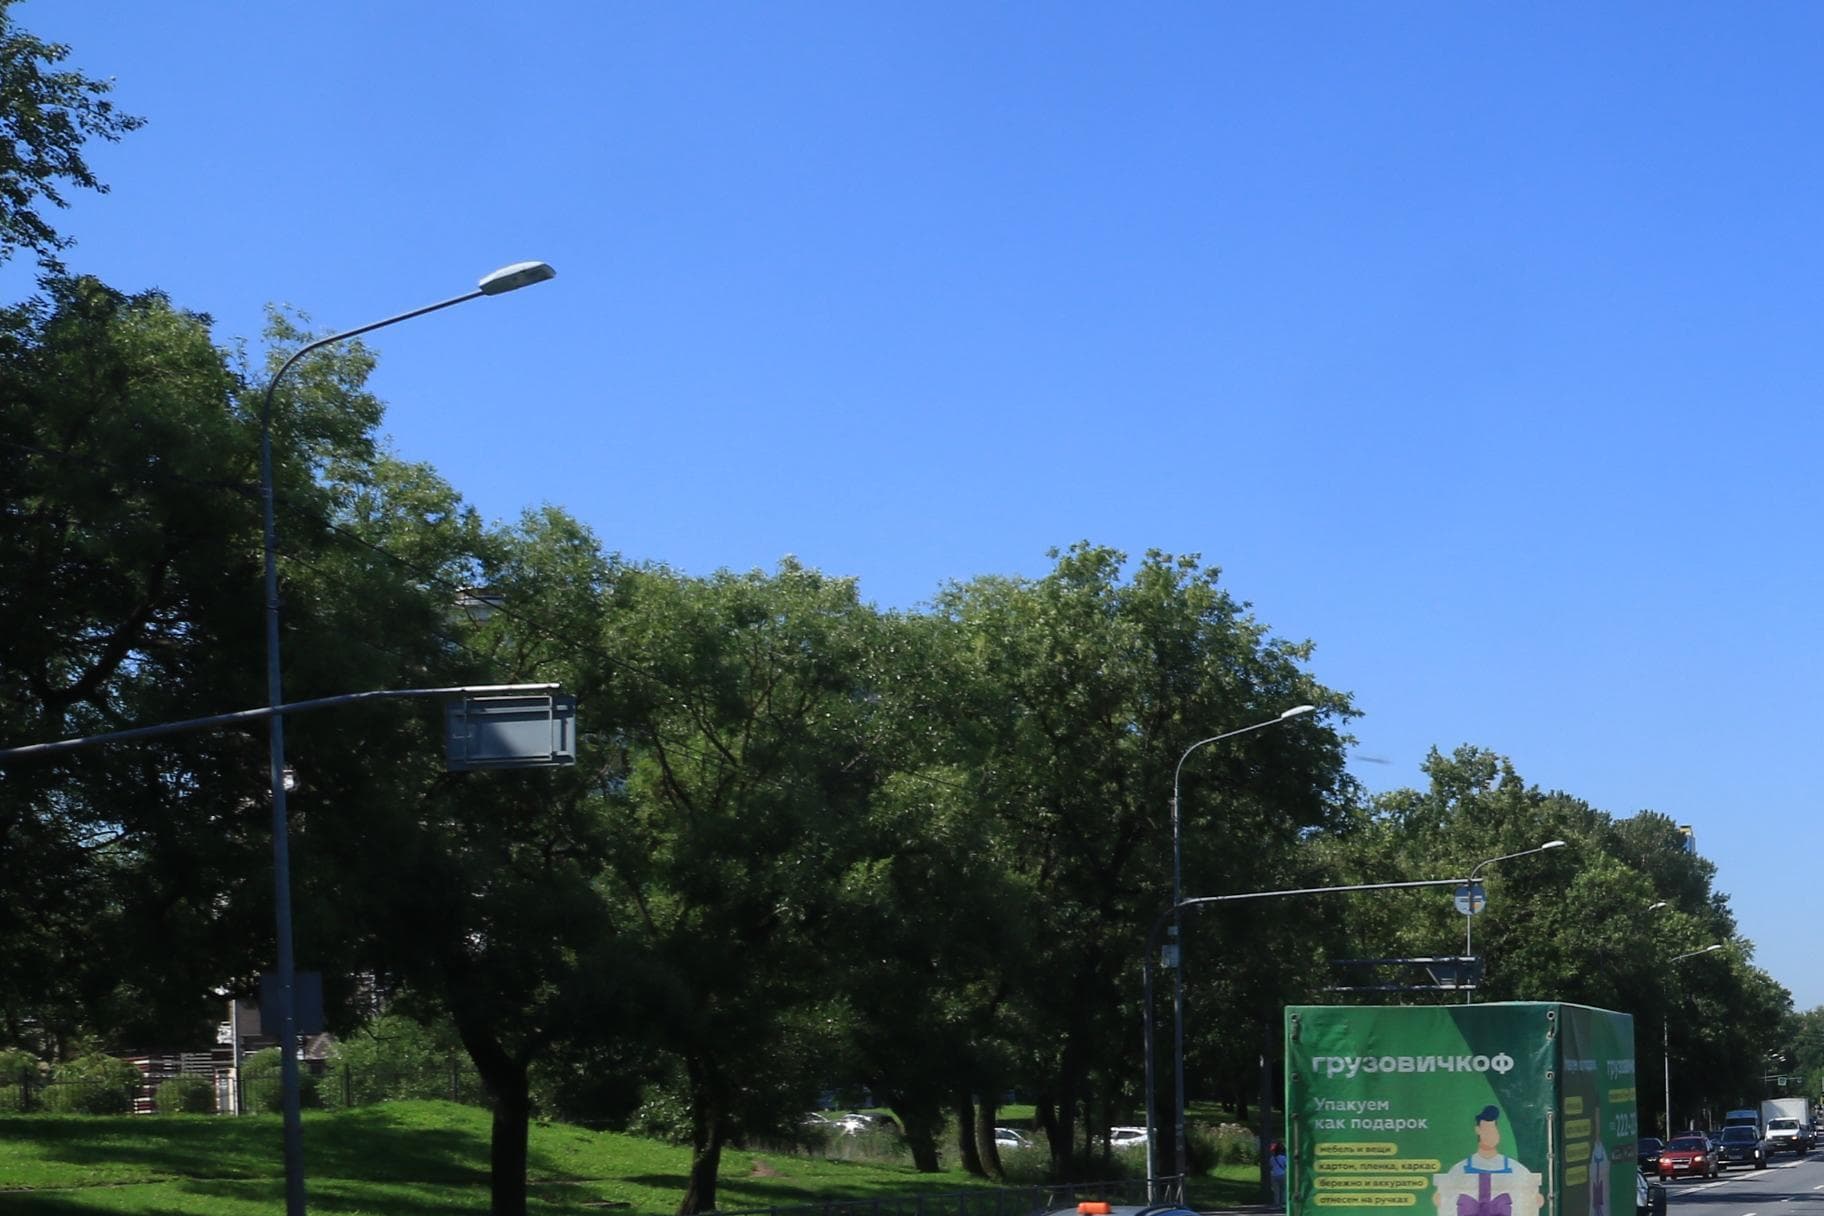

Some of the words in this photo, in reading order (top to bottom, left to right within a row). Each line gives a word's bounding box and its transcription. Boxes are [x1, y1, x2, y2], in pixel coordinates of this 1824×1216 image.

[1311, 1052, 1515, 1078] грузовичкоф
[1314, 1097, 1390, 1114] Упакуем
[1315, 1118, 1346, 1129] как
[1351, 1118, 1428, 1132] подарок
[1401, 1163, 1437, 1171] каркас
